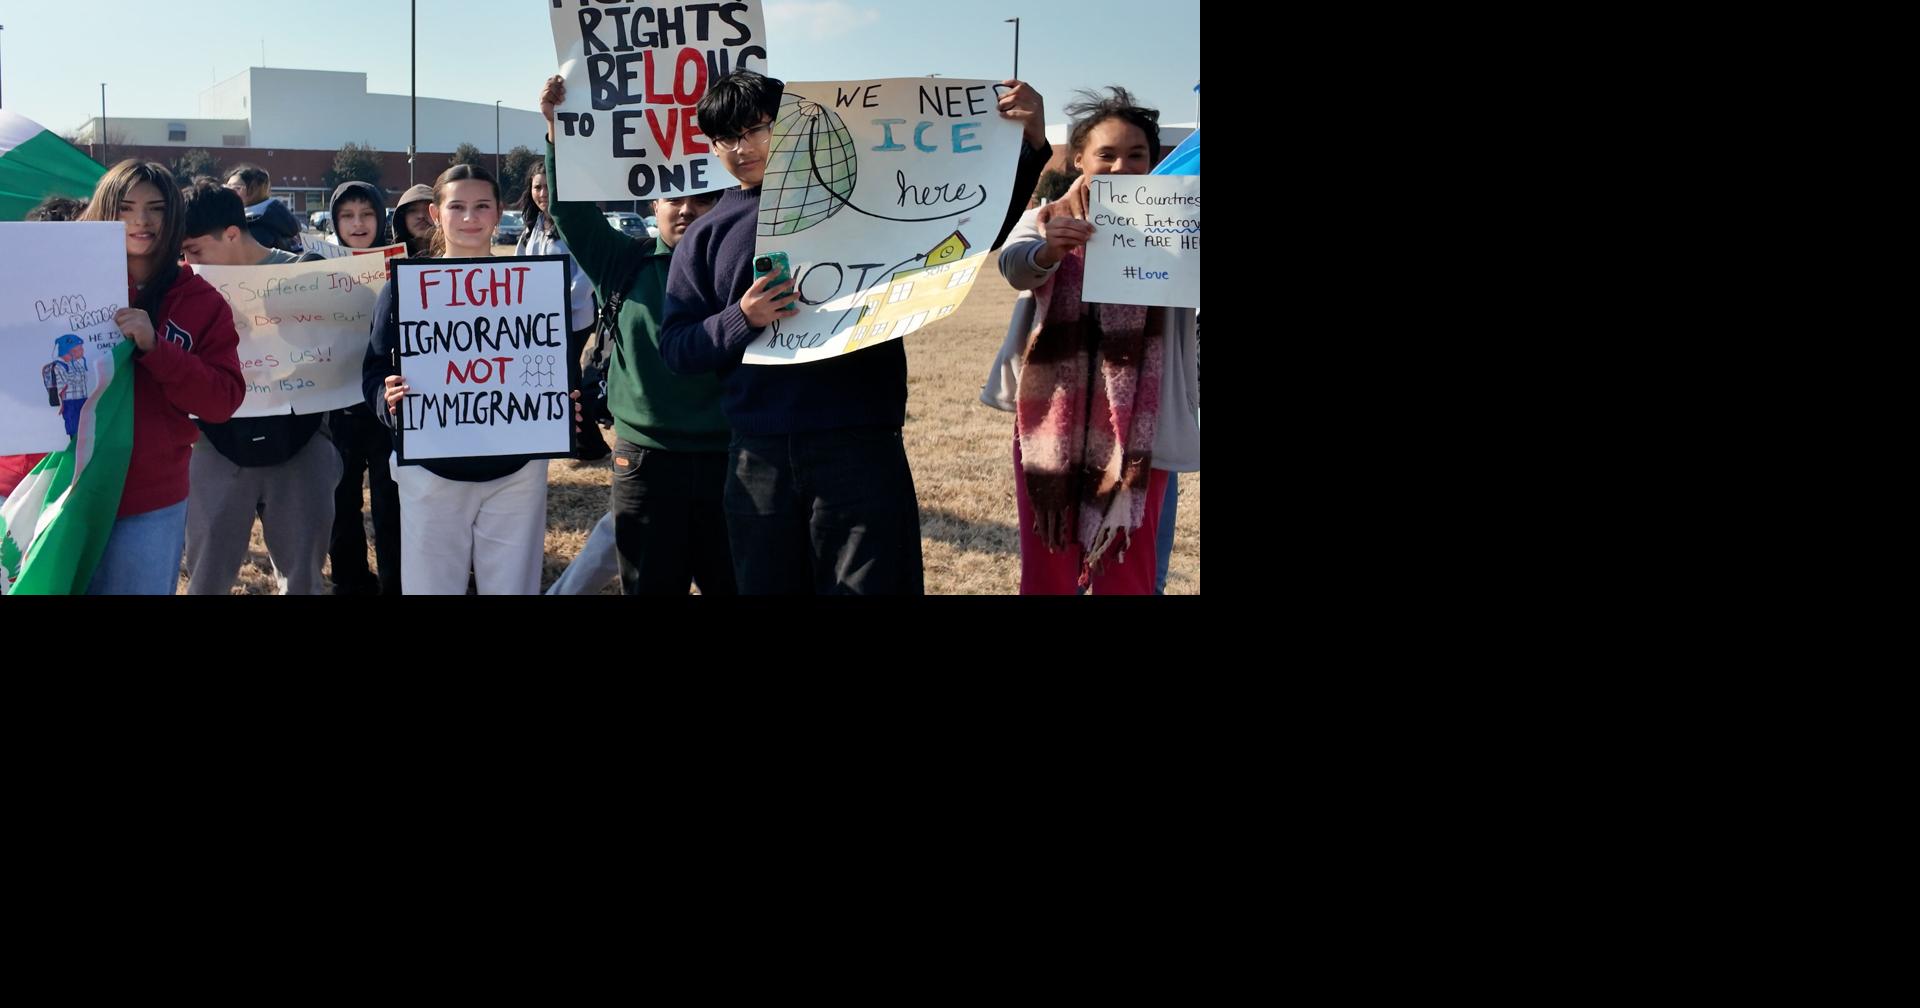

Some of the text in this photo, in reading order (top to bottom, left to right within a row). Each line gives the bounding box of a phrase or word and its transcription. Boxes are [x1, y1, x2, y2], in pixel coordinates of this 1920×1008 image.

[578, 3, 752, 56] RIGHTS
[836, 84, 882, 108] WE
[557, 112, 595, 137] TO
[612, 107, 710, 160] EVE
[871, 118, 982, 153] ICE
[628, 159, 709, 197] ONE
[896, 170, 977, 206] here
[1090, 180, 1129, 204] The
[1094, 213, 1200, 229] even Introv
[1112, 234, 1200, 249] Me ARE HE
[1122, 266, 1169, 280] #Love
[238, 278, 320, 301] Suffered
[419, 267, 531, 309] FIGHT
[255, 315, 282, 326] Do
[399, 312, 561, 357] IGNORANCE
[445, 357, 514, 384] NOT
[246, 382, 272, 393] ohn
[403, 390, 568, 431] IMMIGRANTS
